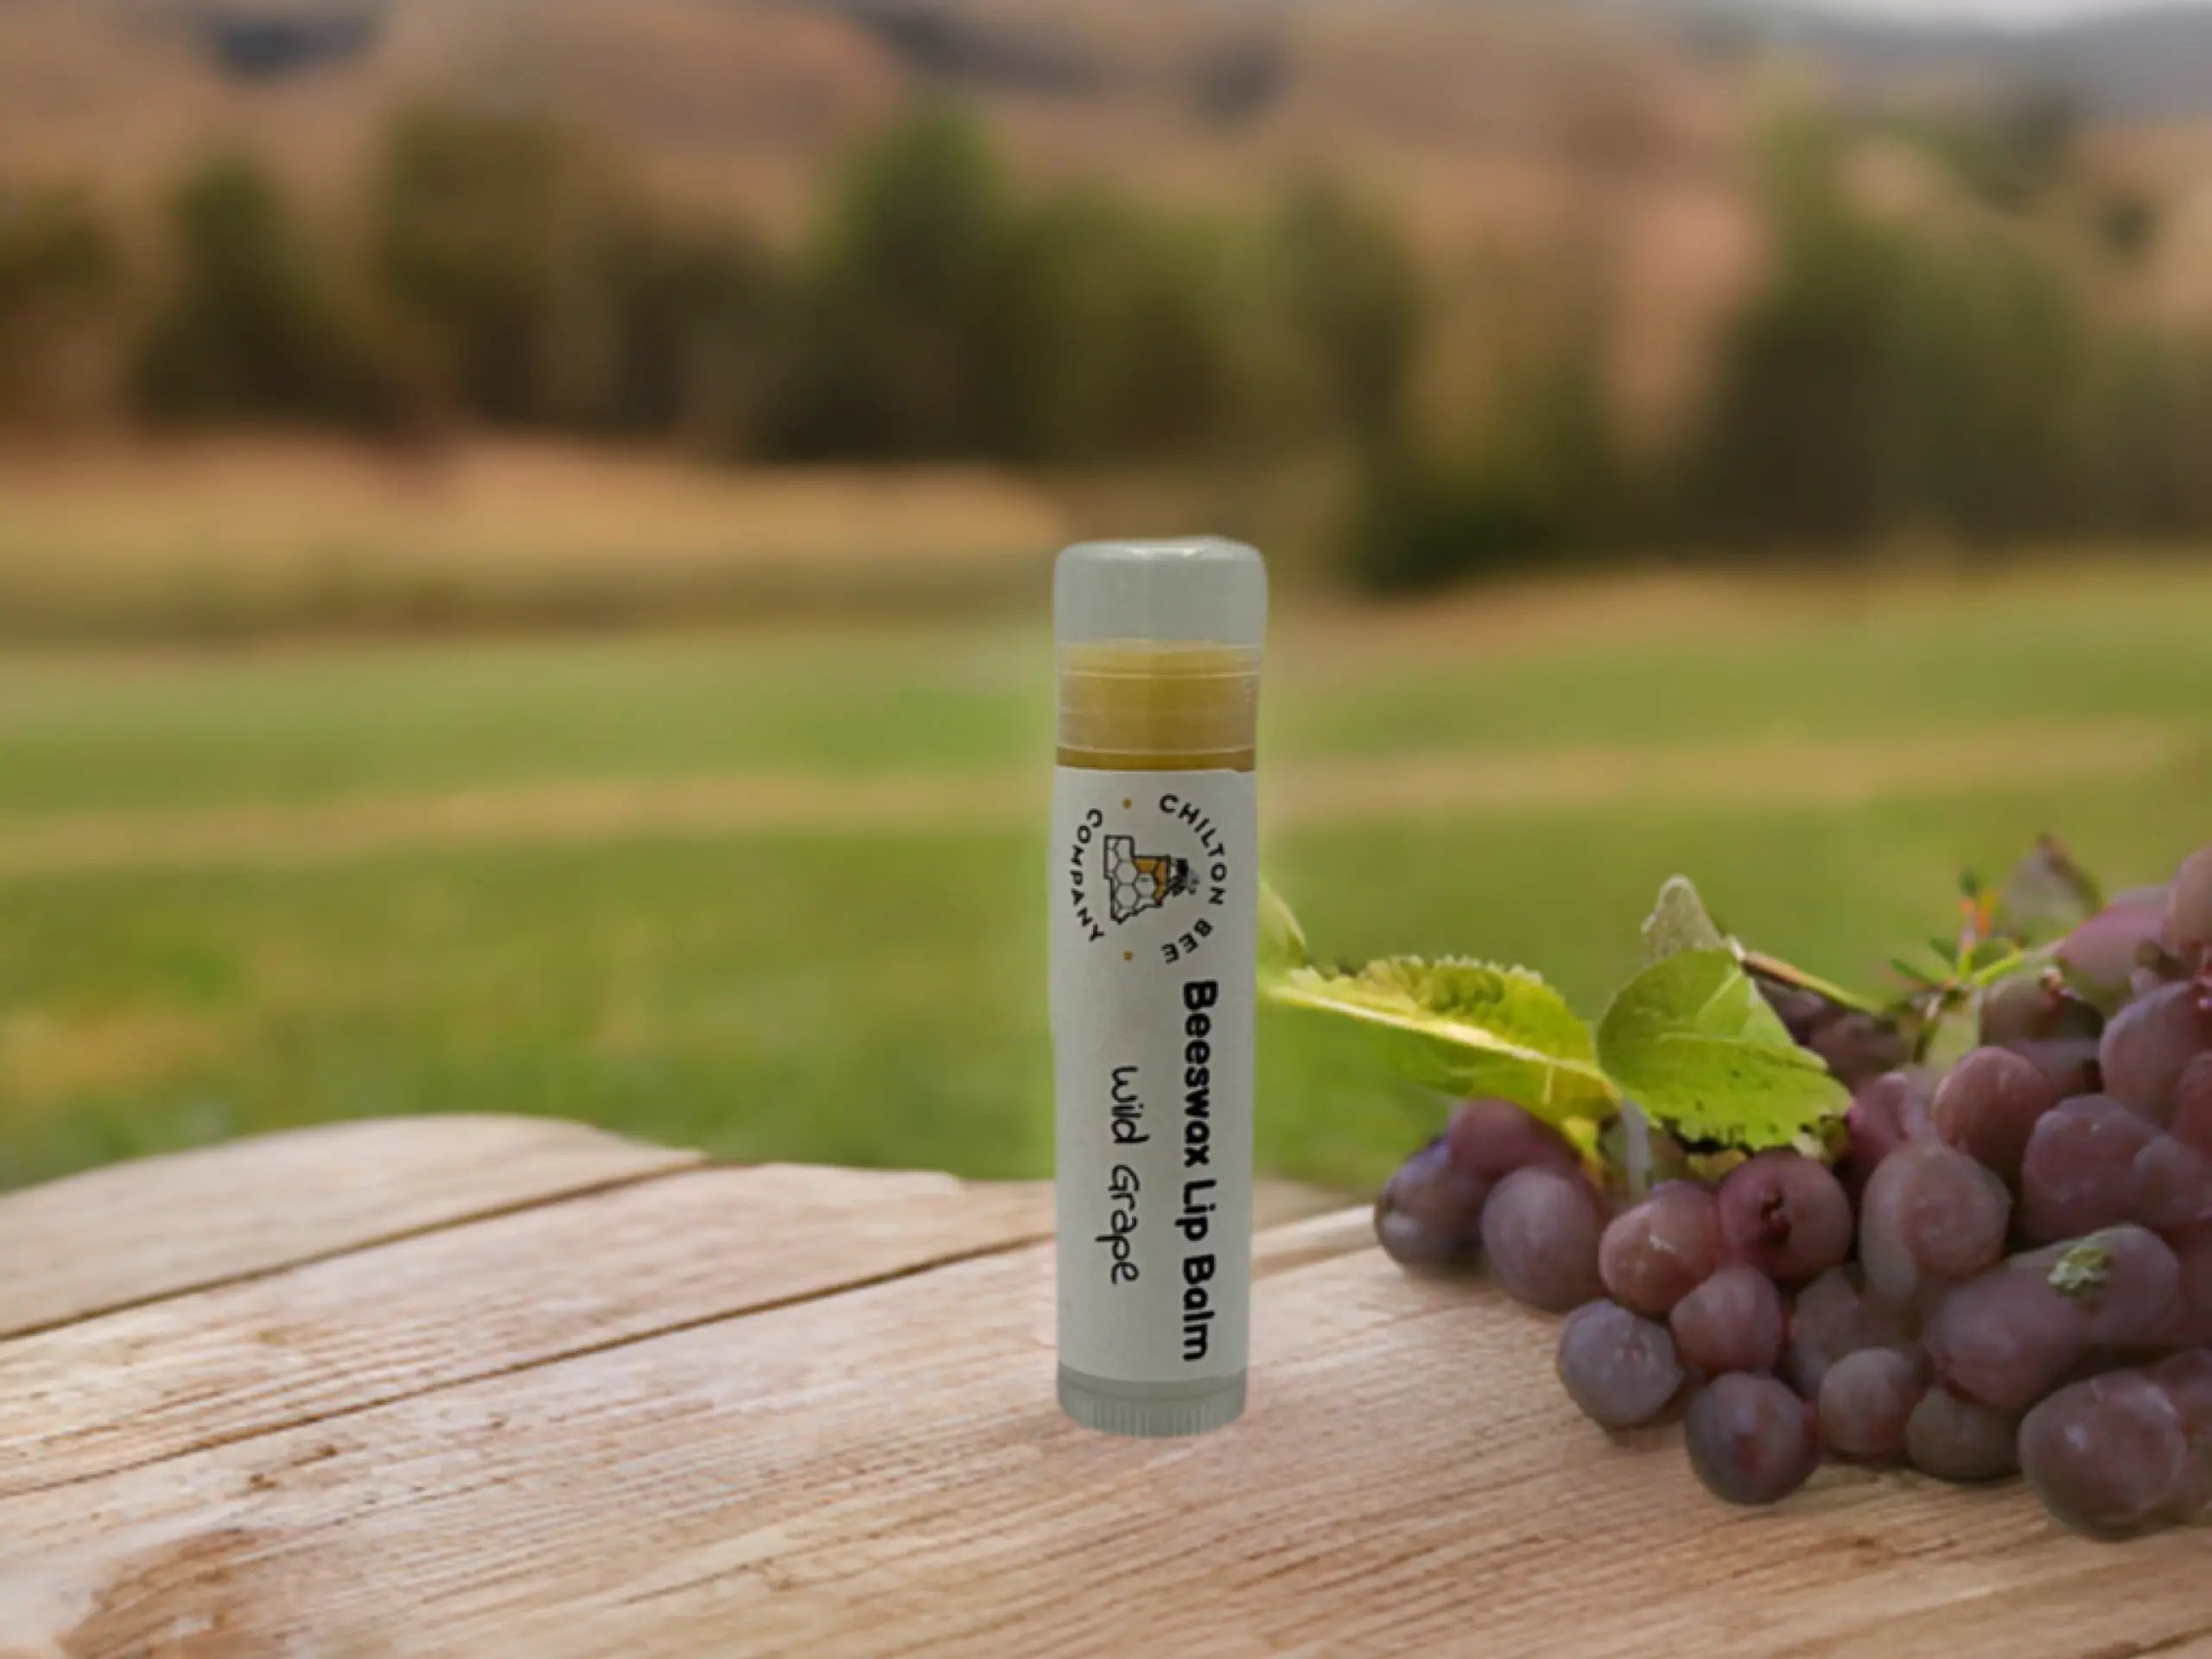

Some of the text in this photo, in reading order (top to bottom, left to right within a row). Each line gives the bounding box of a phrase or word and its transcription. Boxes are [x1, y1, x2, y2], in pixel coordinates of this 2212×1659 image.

[1070, 808, 1104, 942] COMPANY
[1158, 792, 1228, 965] CHILTON BEE
[1094, 1164, 1141, 1285] Grape
[1173, 978, 1219, 1363] Beeswax Lip Balm
